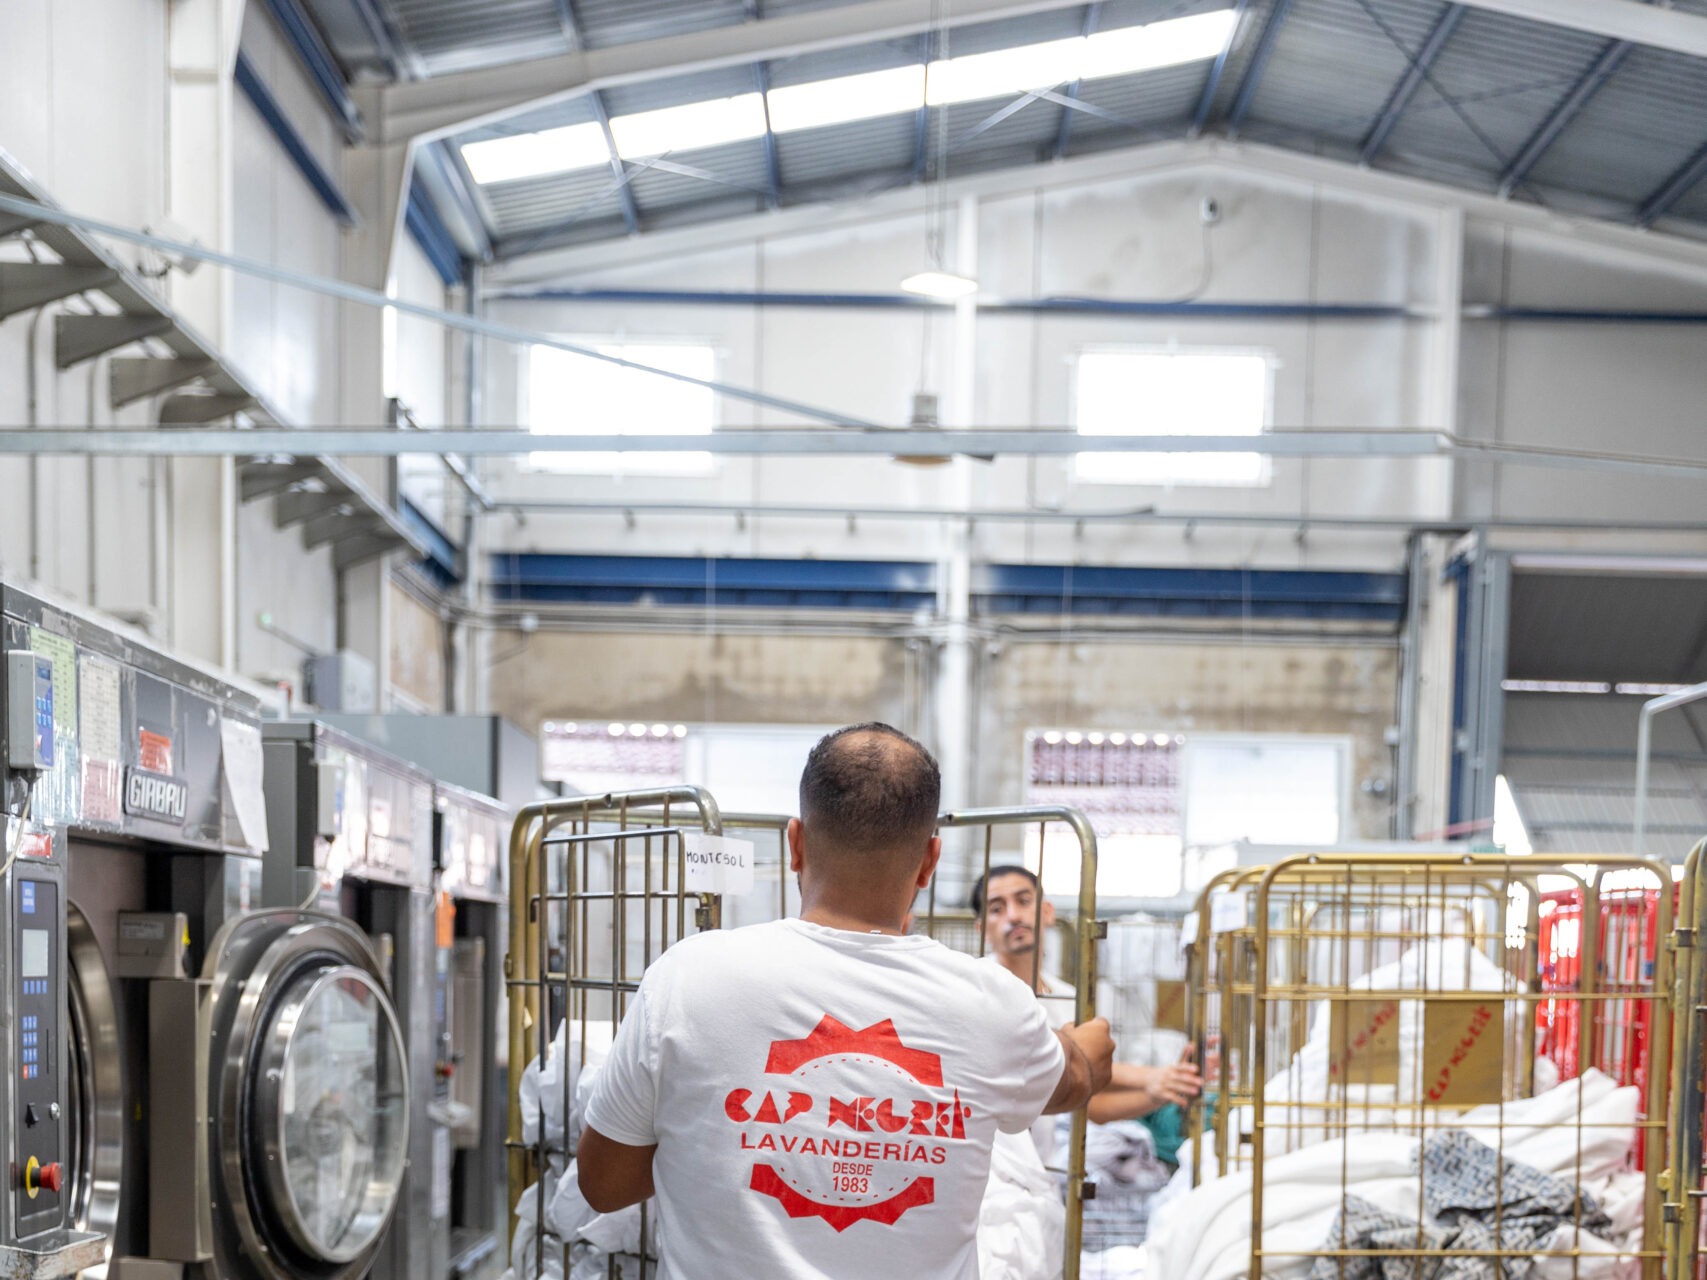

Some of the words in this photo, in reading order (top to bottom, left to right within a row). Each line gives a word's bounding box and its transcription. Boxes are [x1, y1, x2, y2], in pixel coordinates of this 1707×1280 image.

[130, 774, 186, 817] GIRBAU
[686, 851, 745, 868] MONTESOL
[725, 1088, 813, 1124] CAP
[741, 1132, 946, 1164] LAVANDERÍAS
[832, 1162, 873, 1176] DESDE
[832, 1176, 868, 1193] 1983
